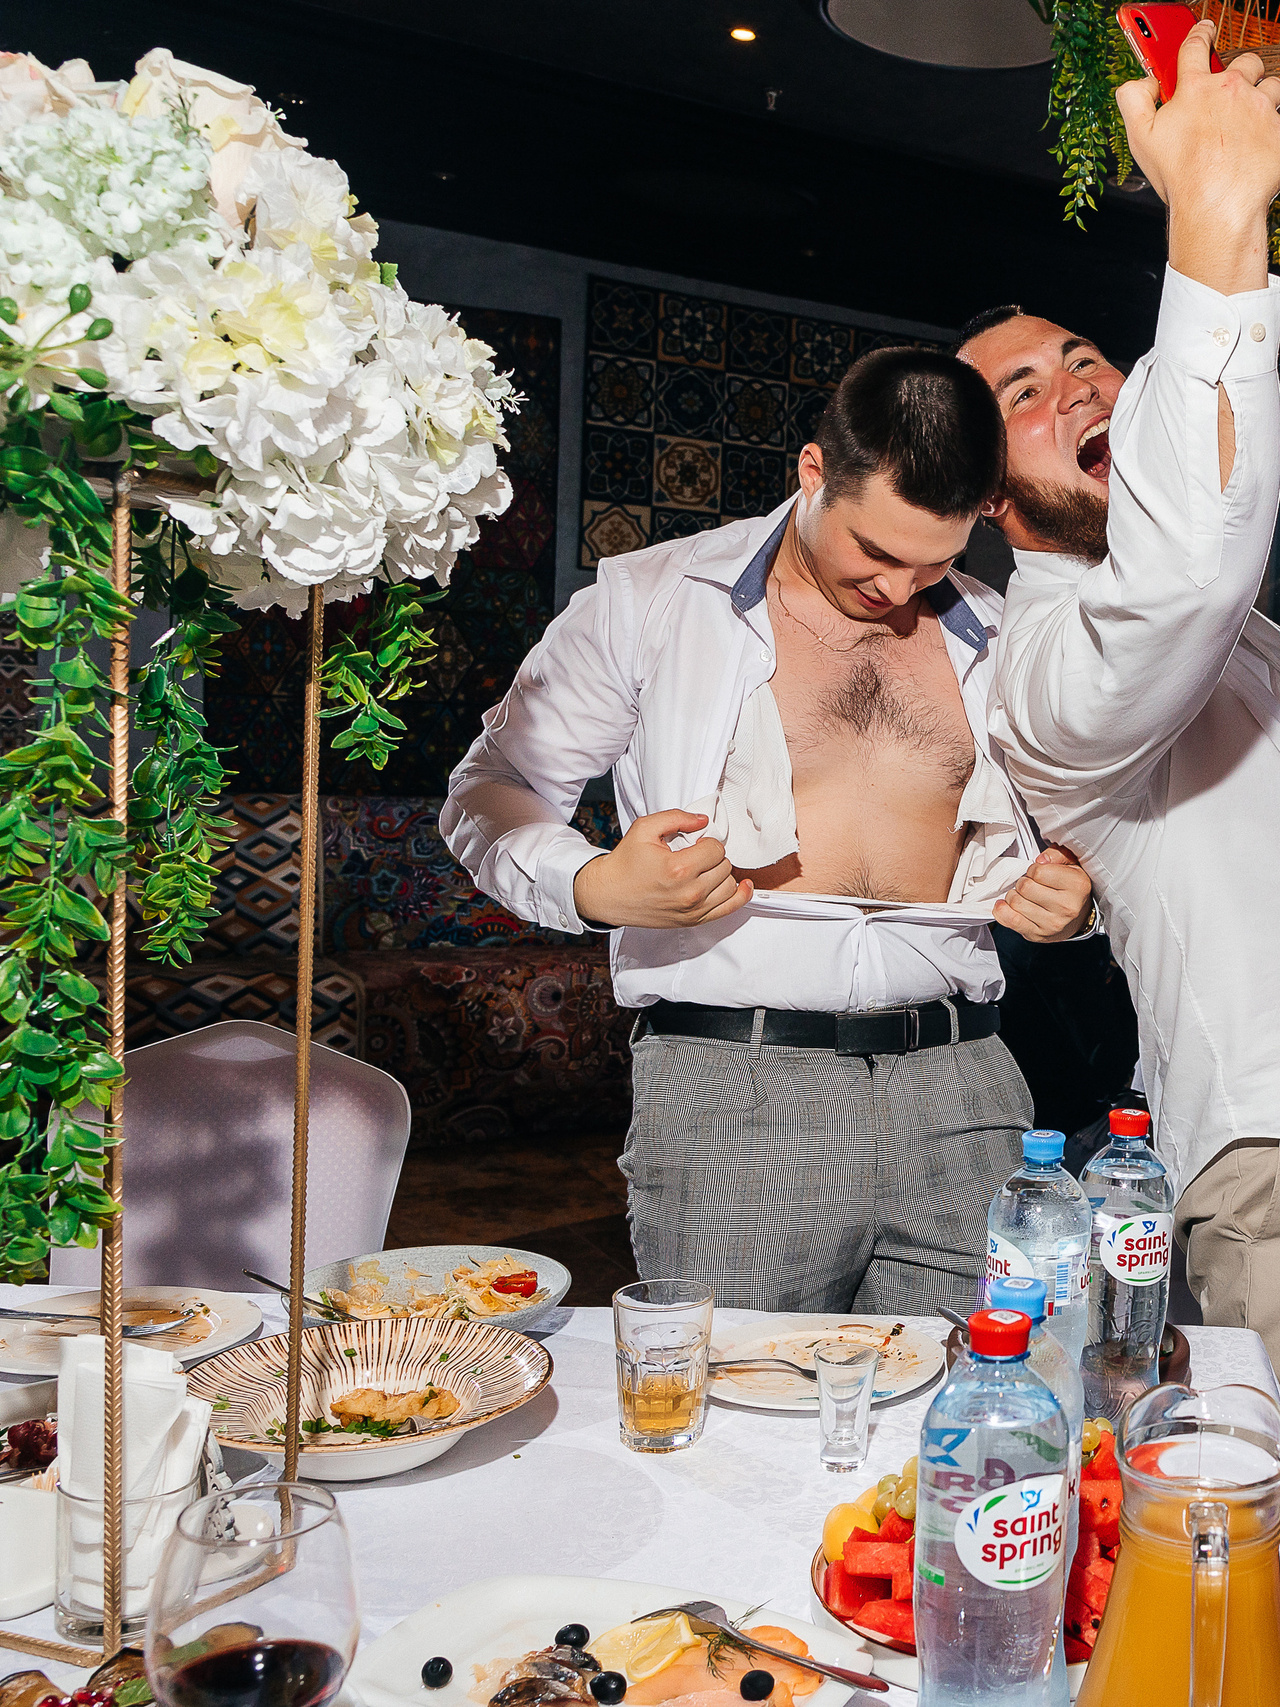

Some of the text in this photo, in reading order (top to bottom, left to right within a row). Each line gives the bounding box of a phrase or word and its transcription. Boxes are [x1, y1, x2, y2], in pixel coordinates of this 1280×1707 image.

[1124, 1231, 1167, 1251] saint
[985, 1254, 1011, 1277] aint
[1116, 1247, 1169, 1272] spring
[993, 1502, 1060, 1538] saint
[981, 1524, 1062, 1570] spring
